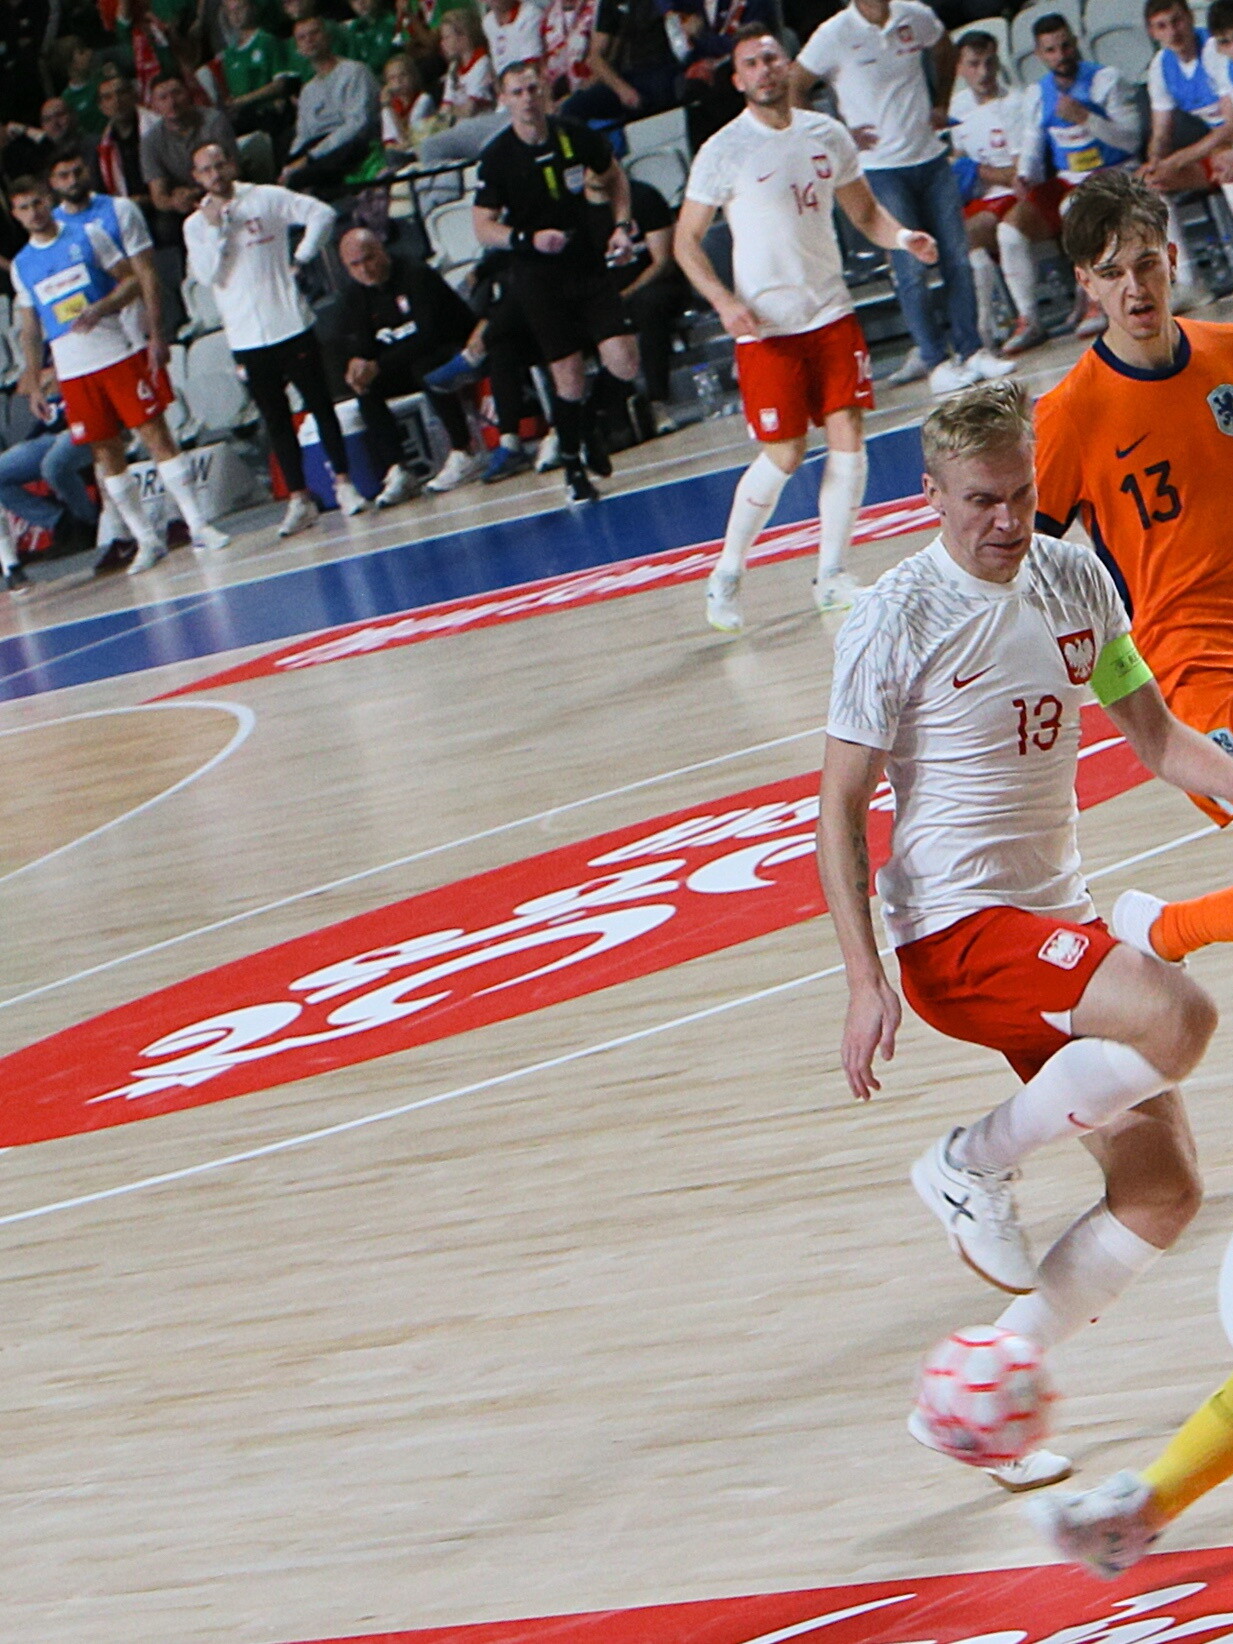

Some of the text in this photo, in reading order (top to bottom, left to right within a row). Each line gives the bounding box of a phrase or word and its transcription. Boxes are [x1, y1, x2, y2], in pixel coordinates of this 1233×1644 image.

[790, 182, 818, 215] 14
[1120, 460, 1183, 530] 13
[1012, 694, 1063, 756] 13
